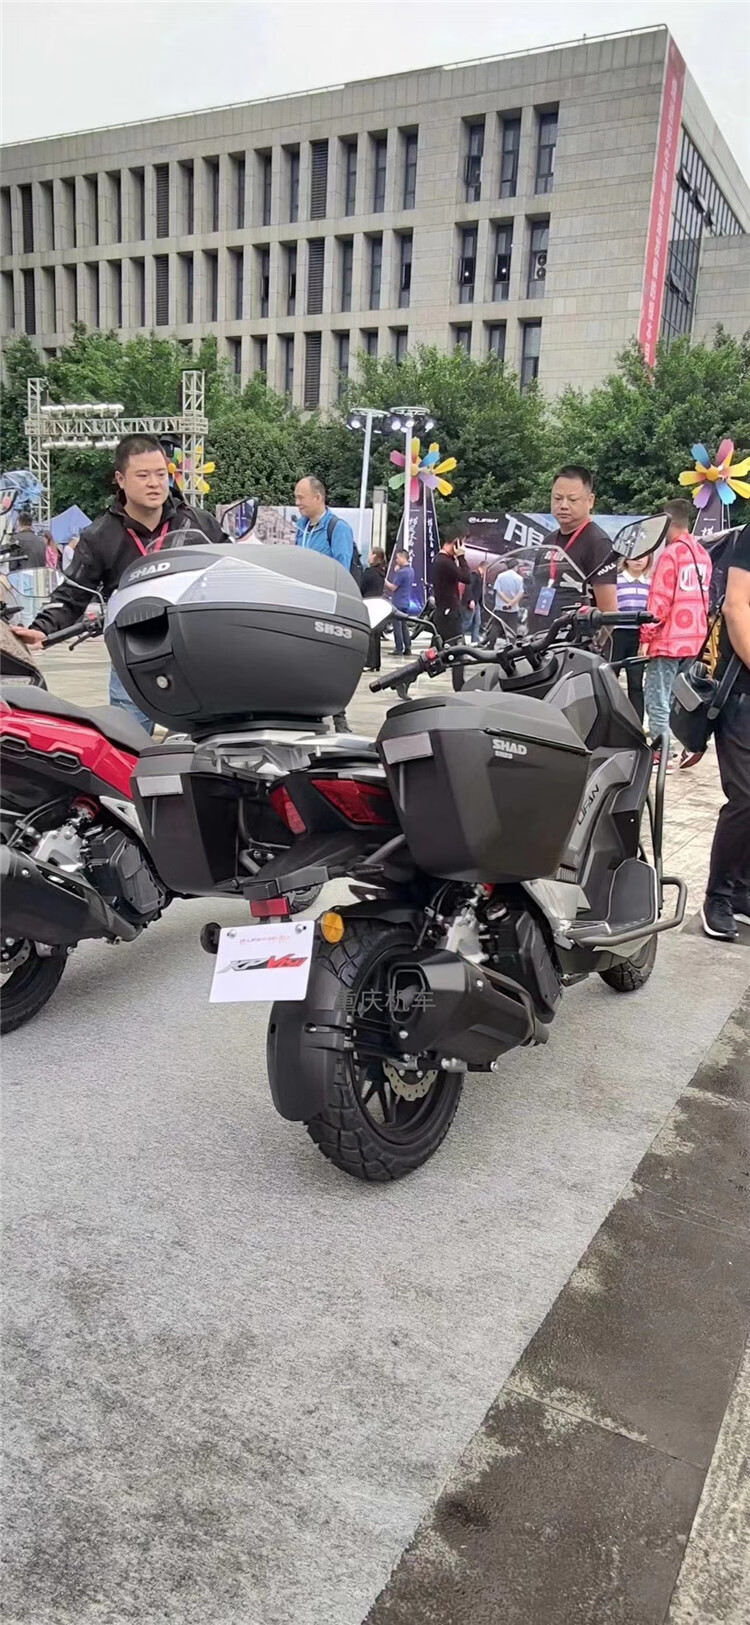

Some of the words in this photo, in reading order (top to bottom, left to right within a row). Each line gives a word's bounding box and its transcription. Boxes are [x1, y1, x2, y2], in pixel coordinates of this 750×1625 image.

[128, 562, 171, 582] SHAD
[314, 621, 353, 639] SH33
[492, 738, 528, 756] SHAD
